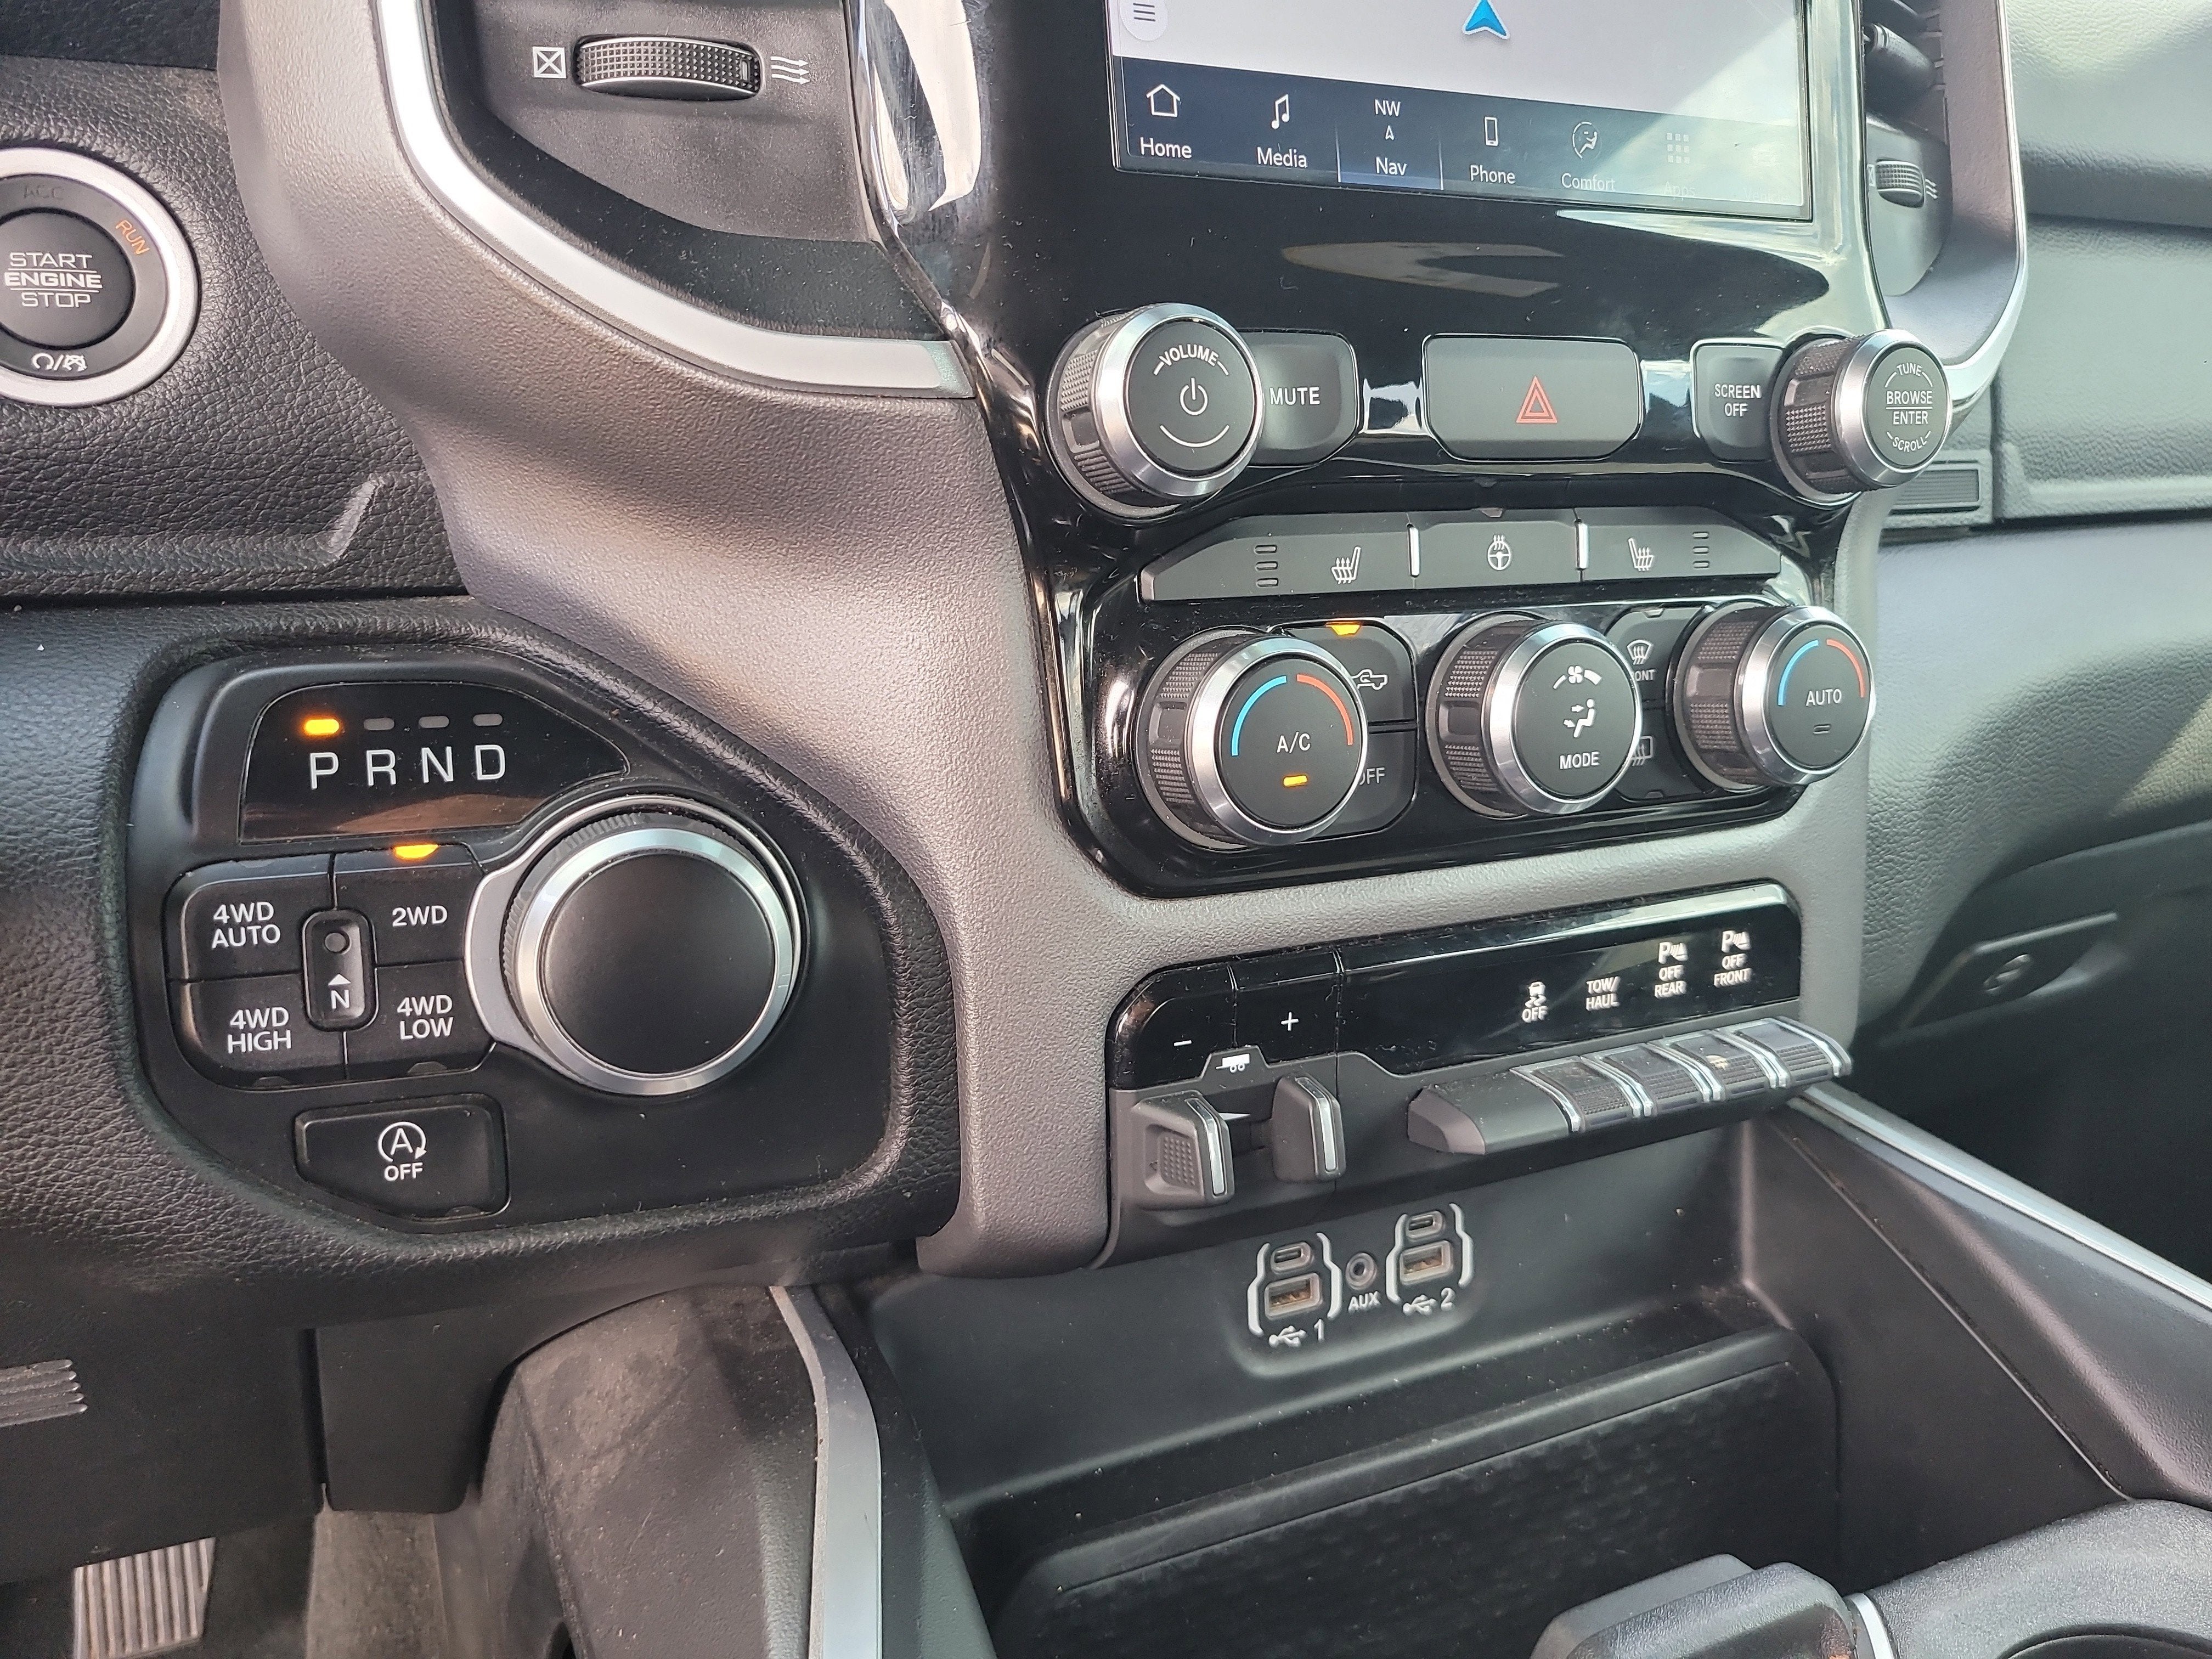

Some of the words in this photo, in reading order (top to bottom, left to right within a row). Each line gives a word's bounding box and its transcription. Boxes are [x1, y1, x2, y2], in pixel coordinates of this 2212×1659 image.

[1374, 99, 1400, 117] NW
[1140, 137, 1192, 159] Home
[1257, 147, 1307, 168] Media
[1376, 157, 1407, 176] Nav
[1470, 165, 1516, 184] Phone
[1561, 173, 1616, 191] Comfort
[1663, 181, 1695, 201] Apps
[24, 185, 64, 201] ACC
[115, 219, 150, 255] RUN
[9, 252, 93, 268] START
[4, 273, 103, 289] ENGINE
[21, 292, 91, 308] STOP
[1159, 344, 1219, 367] VOLUME
[1897, 363, 1922, 377] TUNE
[1269, 387, 1321, 405] MUTE
[1714, 384, 1762, 399] SCREEN
[1886, 390, 1932, 404] BROWSE
[1724, 402, 1748, 417] OFF
[1893, 411, 1928, 425] ENTER
[1892, 436, 1927, 453] SCROLL
[1634, 669, 1656, 681] ONT
[1805, 689, 1842, 708] AUTO
[1277, 732, 1311, 754] A/C
[310, 752, 339, 789] P
[366, 749, 397, 786] R
[421, 746, 453, 783] N
[474, 744, 505, 780] D
[1559, 751, 1600, 770] MODE
[213, 901, 274, 923] 4WD
[392, 905, 448, 927] 2WD
[211, 924, 281, 949] AUTO
[1721, 952, 1746, 970] OFF
[1658, 964, 1684, 981] OFF
[1713, 968, 1752, 987] FRONT
[1654, 980, 1686, 998] REAR
[331, 989, 350, 1009] N
[397, 994, 453, 1017] 4WD
[1585, 994, 1620, 1011] HAUL
[229, 1006, 289, 1029] 4WD
[1522, 1006, 1547, 1023] OFF
[399, 1017, 453, 1040] LOW
[227, 1030, 292, 1053] HIGH
[384, 1162, 423, 1181] OFF
[1348, 1291, 1381, 1312] AUX
[1440, 1287, 1455, 1311] 2
[1314, 1318, 1324, 1343] 1
